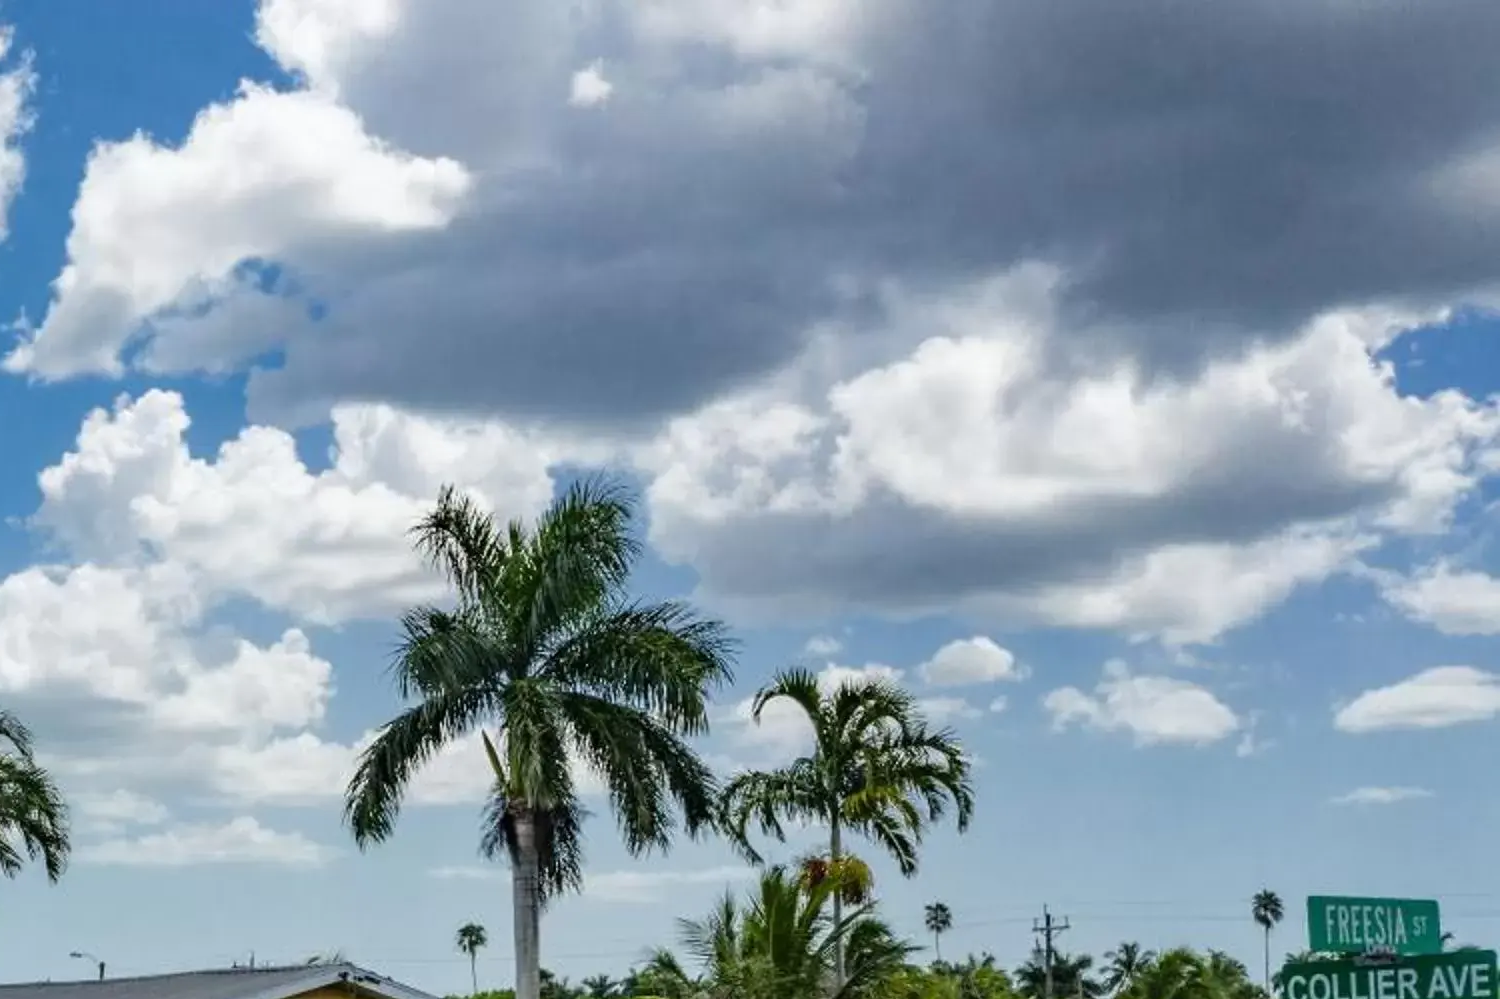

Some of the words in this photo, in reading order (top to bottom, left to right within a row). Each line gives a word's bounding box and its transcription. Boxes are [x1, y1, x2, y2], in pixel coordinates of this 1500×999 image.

[1326, 905, 1407, 945] FREESIA
[1413, 916, 1428, 936] ST
[1428, 964, 1491, 998] AVE
